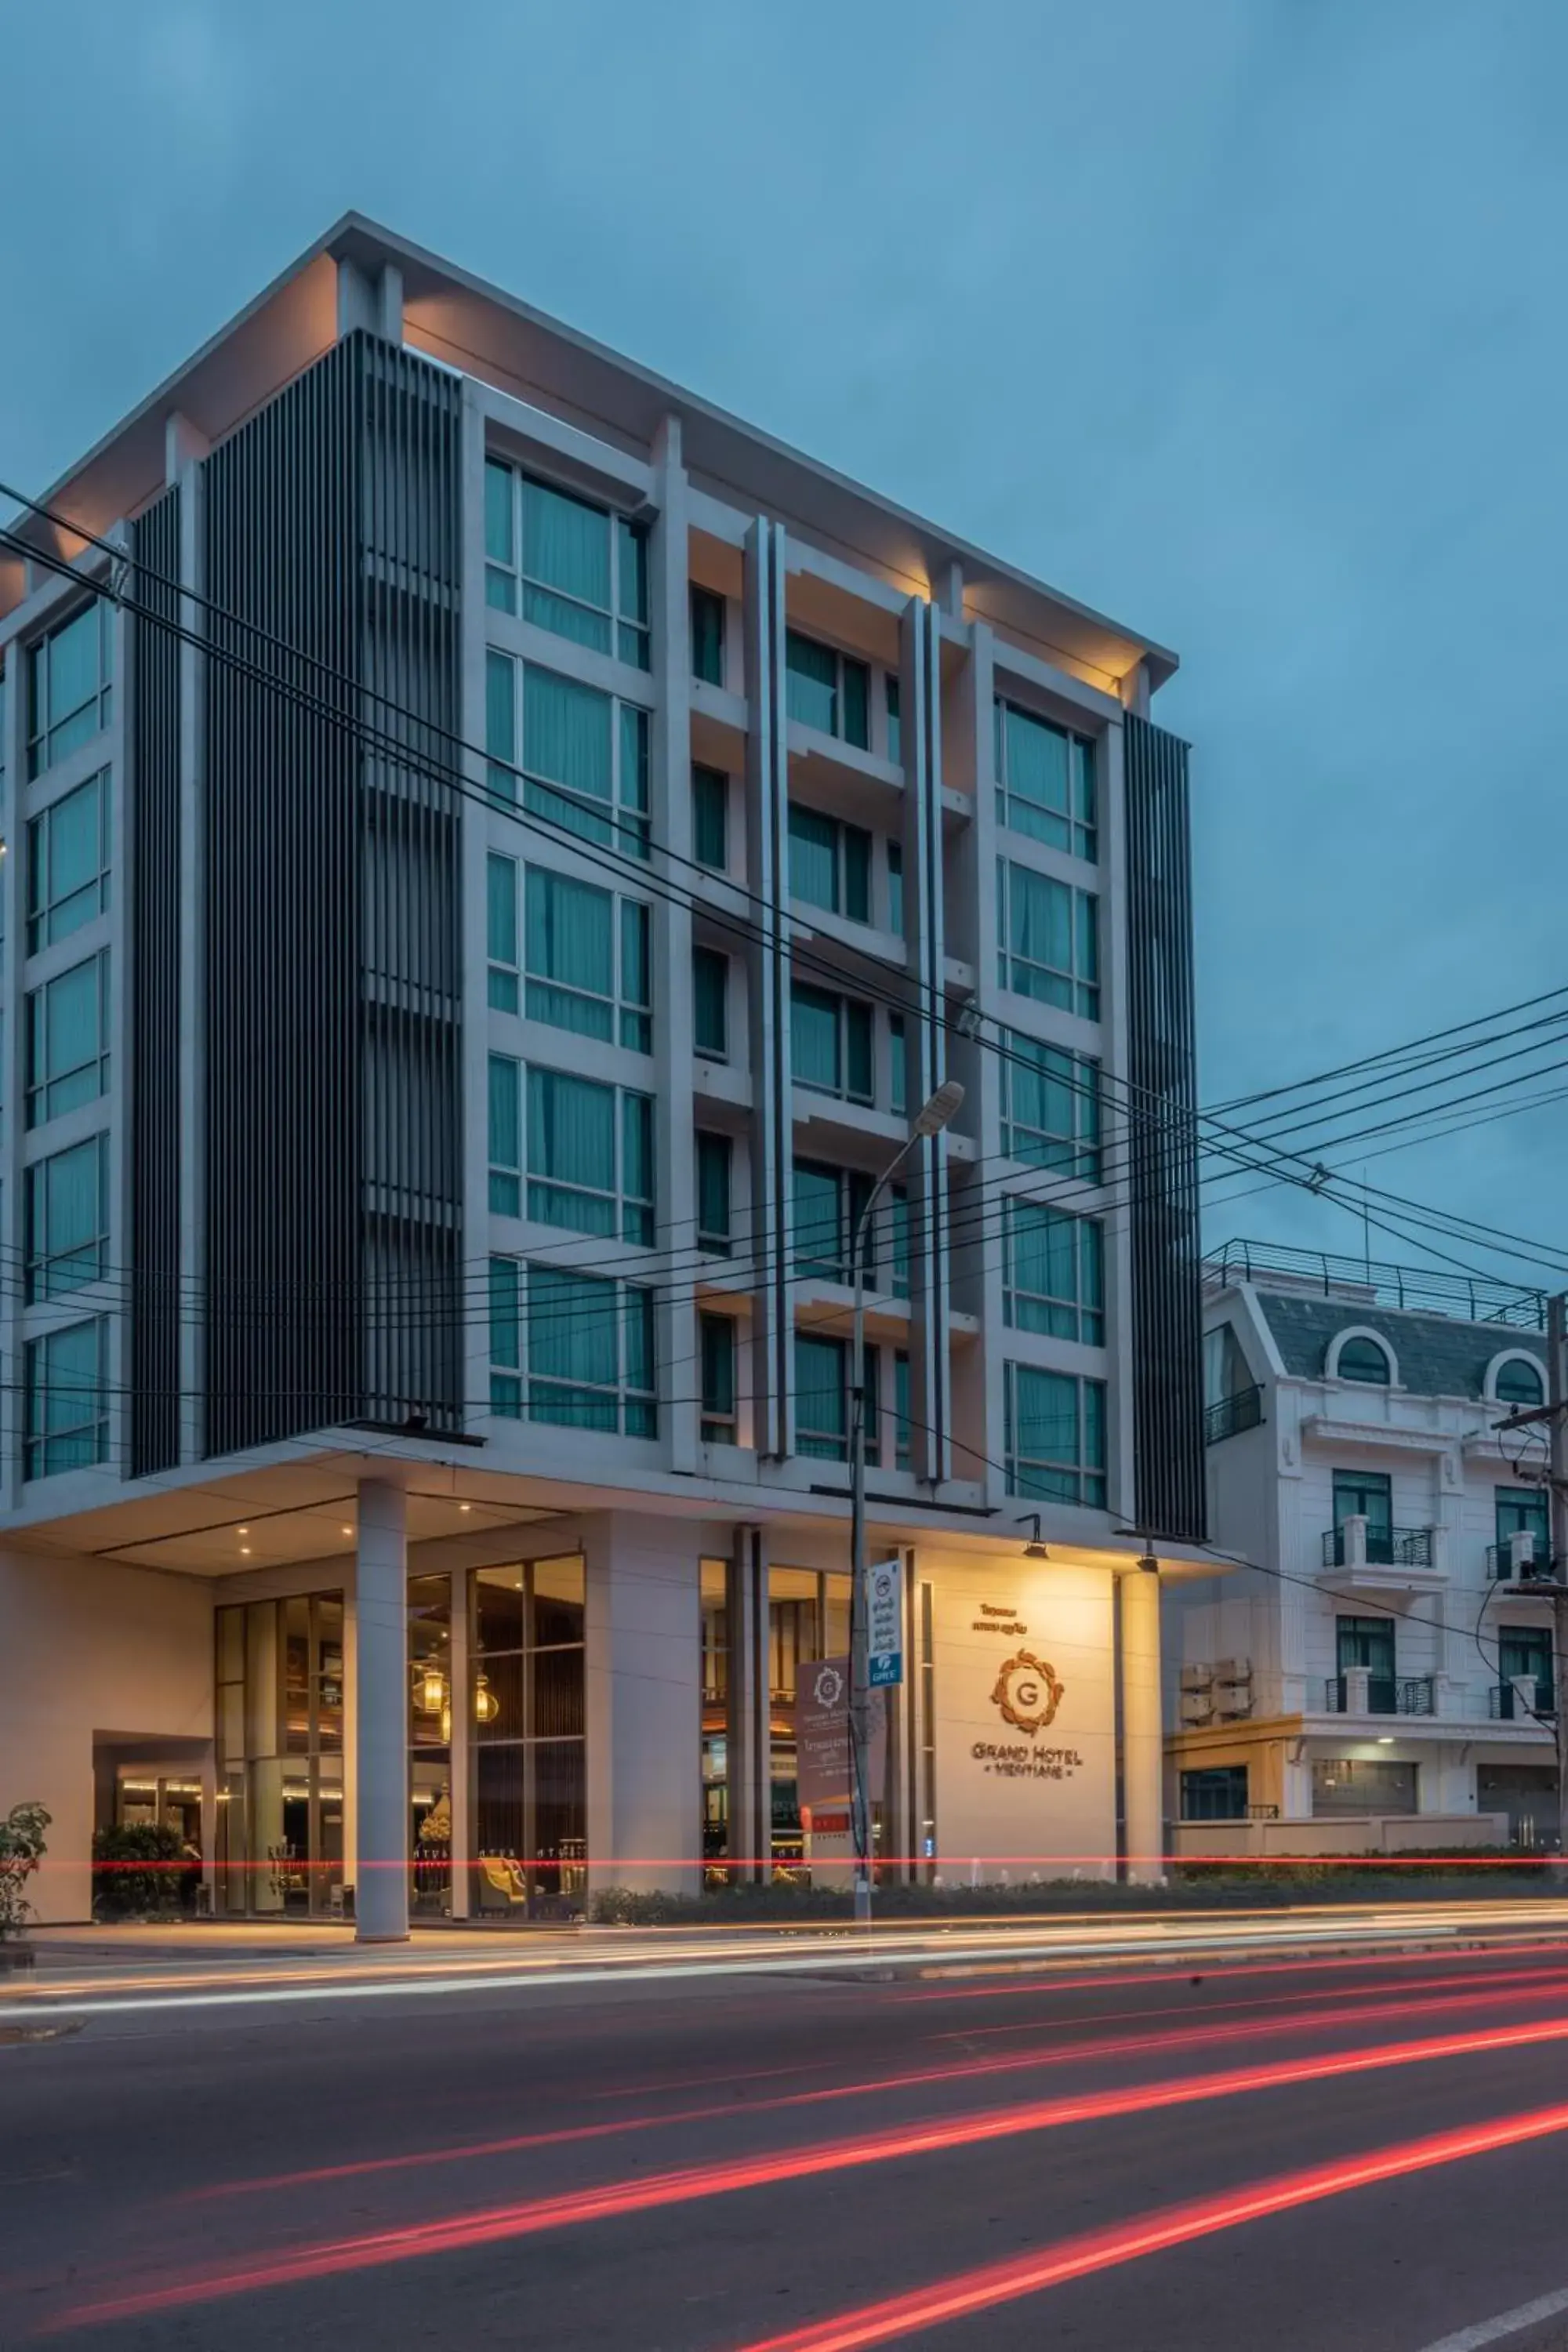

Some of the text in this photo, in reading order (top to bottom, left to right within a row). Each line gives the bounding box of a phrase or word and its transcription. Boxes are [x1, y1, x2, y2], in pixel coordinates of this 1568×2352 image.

[1017, 1682, 1038, 1706] G
[971, 1741, 1083, 1766] GRAND HOTEL
